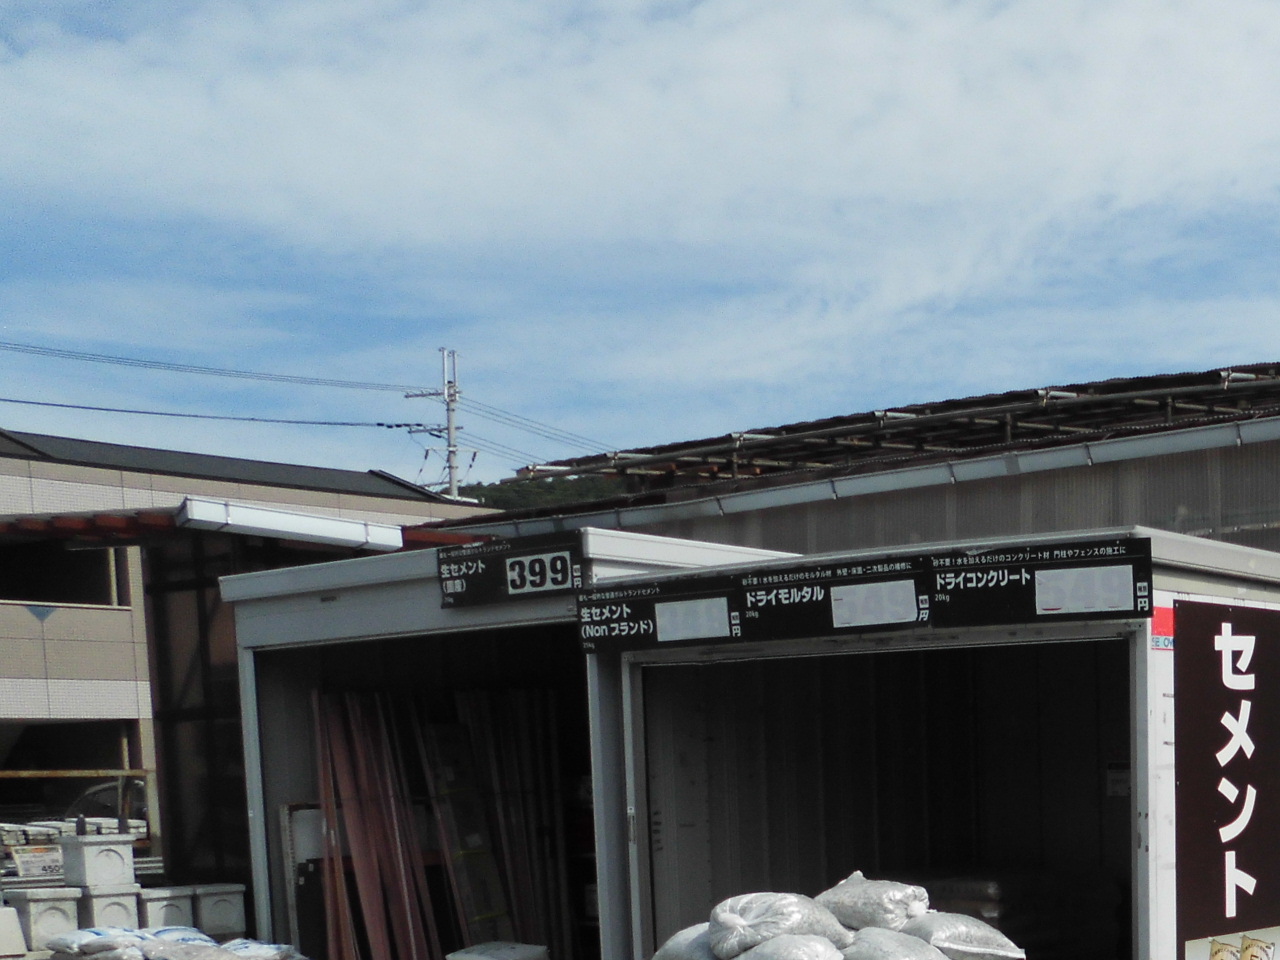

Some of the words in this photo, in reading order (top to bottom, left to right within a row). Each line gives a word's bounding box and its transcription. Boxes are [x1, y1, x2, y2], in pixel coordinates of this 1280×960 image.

[440, 560, 486, 578] 生セメント
[508, 555, 570, 590] 399
[936, 568, 1031, 590] ドライコンクリート
[746, 586, 825, 607] ドライモルタル
[935, 594, 950, 603] 20kg
[1138, 598, 1149, 611] 円
[580, 603, 631, 622] 生セメント
[919, 610, 929, 621] 円
[732, 626, 741, 637] 円
[1214, 622, 1257, 918] セメント
